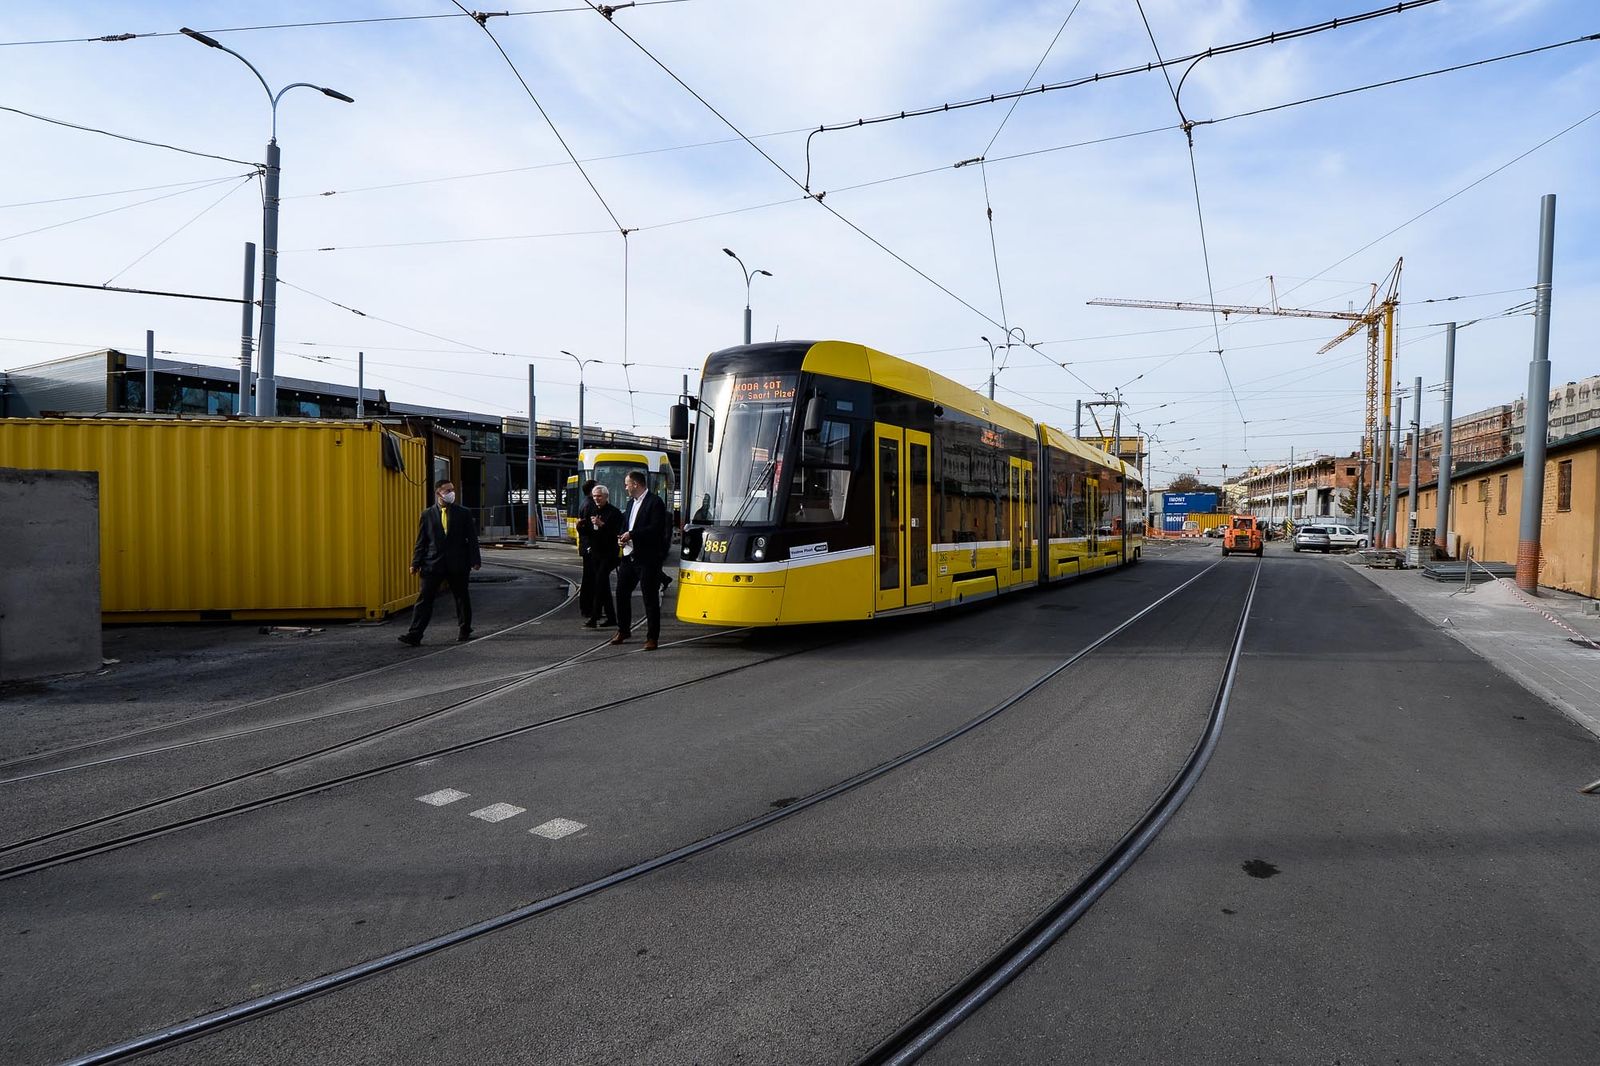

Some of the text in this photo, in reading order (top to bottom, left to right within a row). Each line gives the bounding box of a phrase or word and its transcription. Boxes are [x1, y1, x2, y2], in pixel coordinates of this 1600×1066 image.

[734, 380, 781, 391] KODA 40T
[748, 390, 770, 400] Smart
[705, 540, 727, 553] 385
